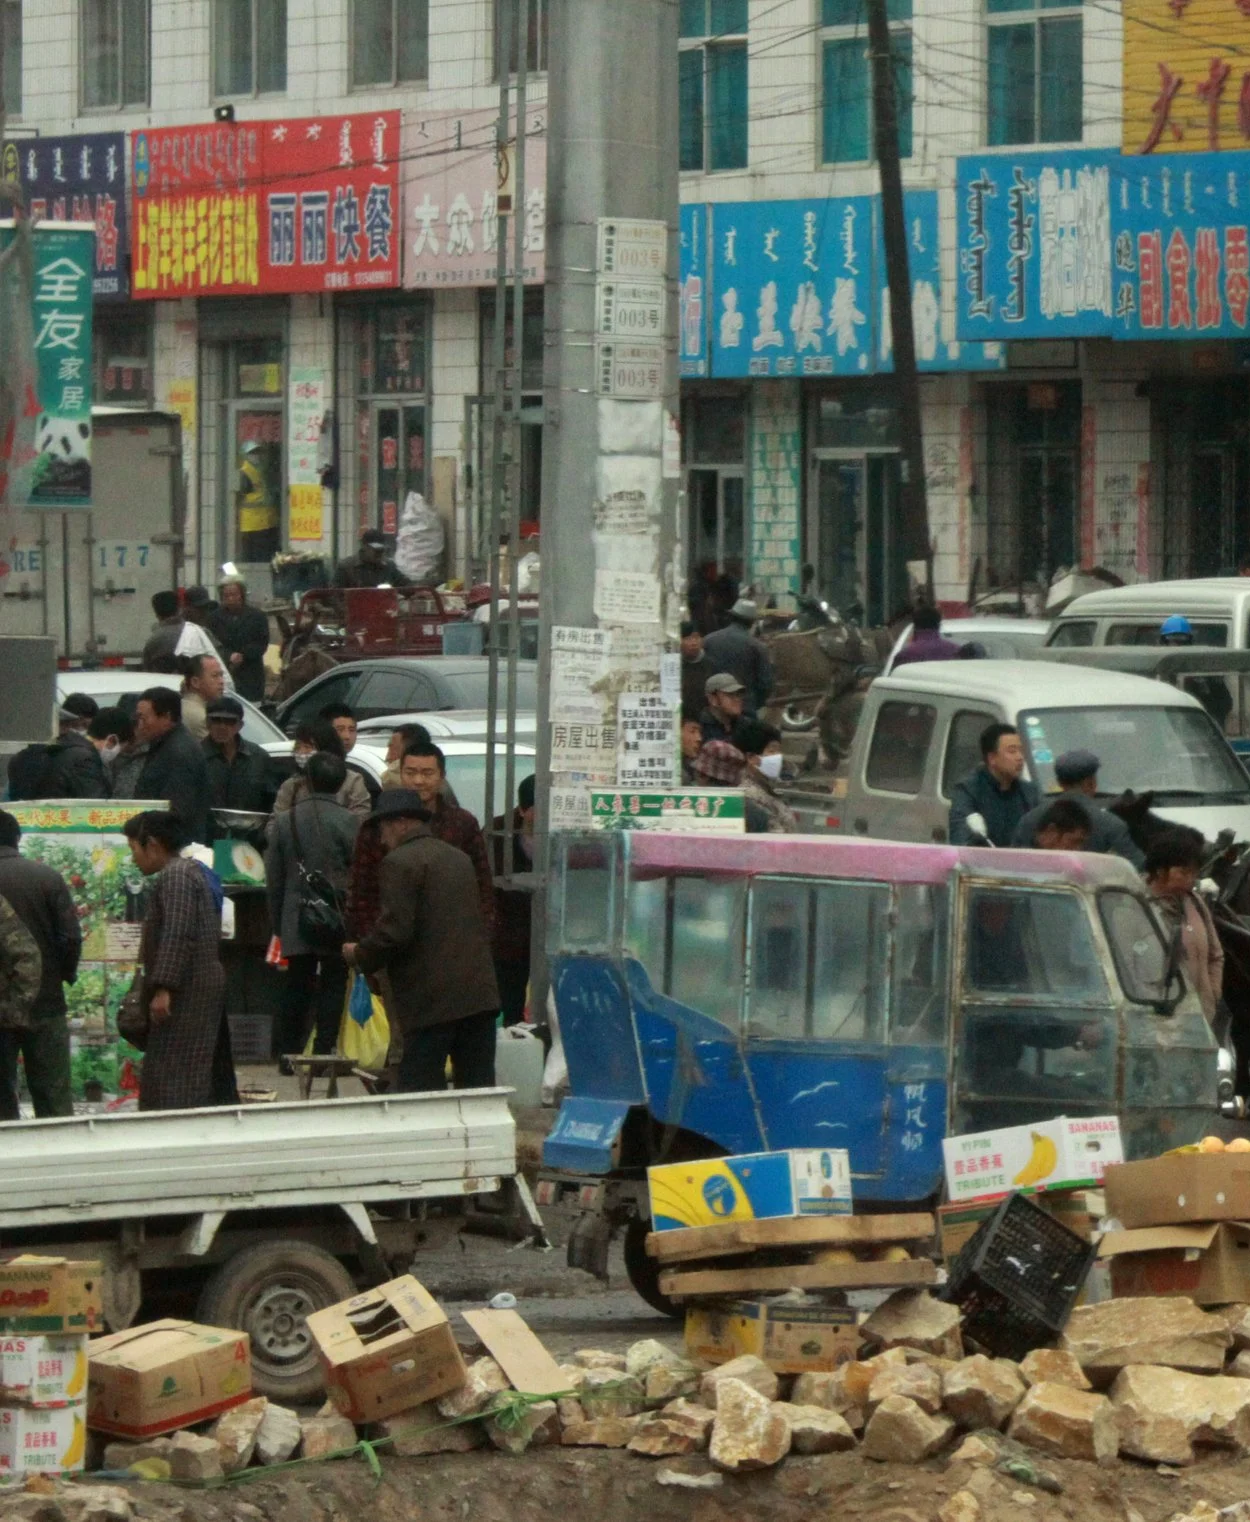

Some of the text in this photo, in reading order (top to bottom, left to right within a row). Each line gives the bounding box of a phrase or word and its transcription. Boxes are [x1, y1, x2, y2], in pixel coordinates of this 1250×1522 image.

[267, 183, 393, 266] 丽丽快餐
[618, 308, 659, 329] 003号
[33, 257, 86, 411] 全友家居
[553, 726, 616, 749] 房屋出售
[1067, 1120, 1117, 1134] BANANAS
[953, 1154, 1004, 1176] 壹品香蕉
[955, 1174, 1005, 1192] TRIBUTE
[24, 1454, 57, 1466] TRIBUTE
